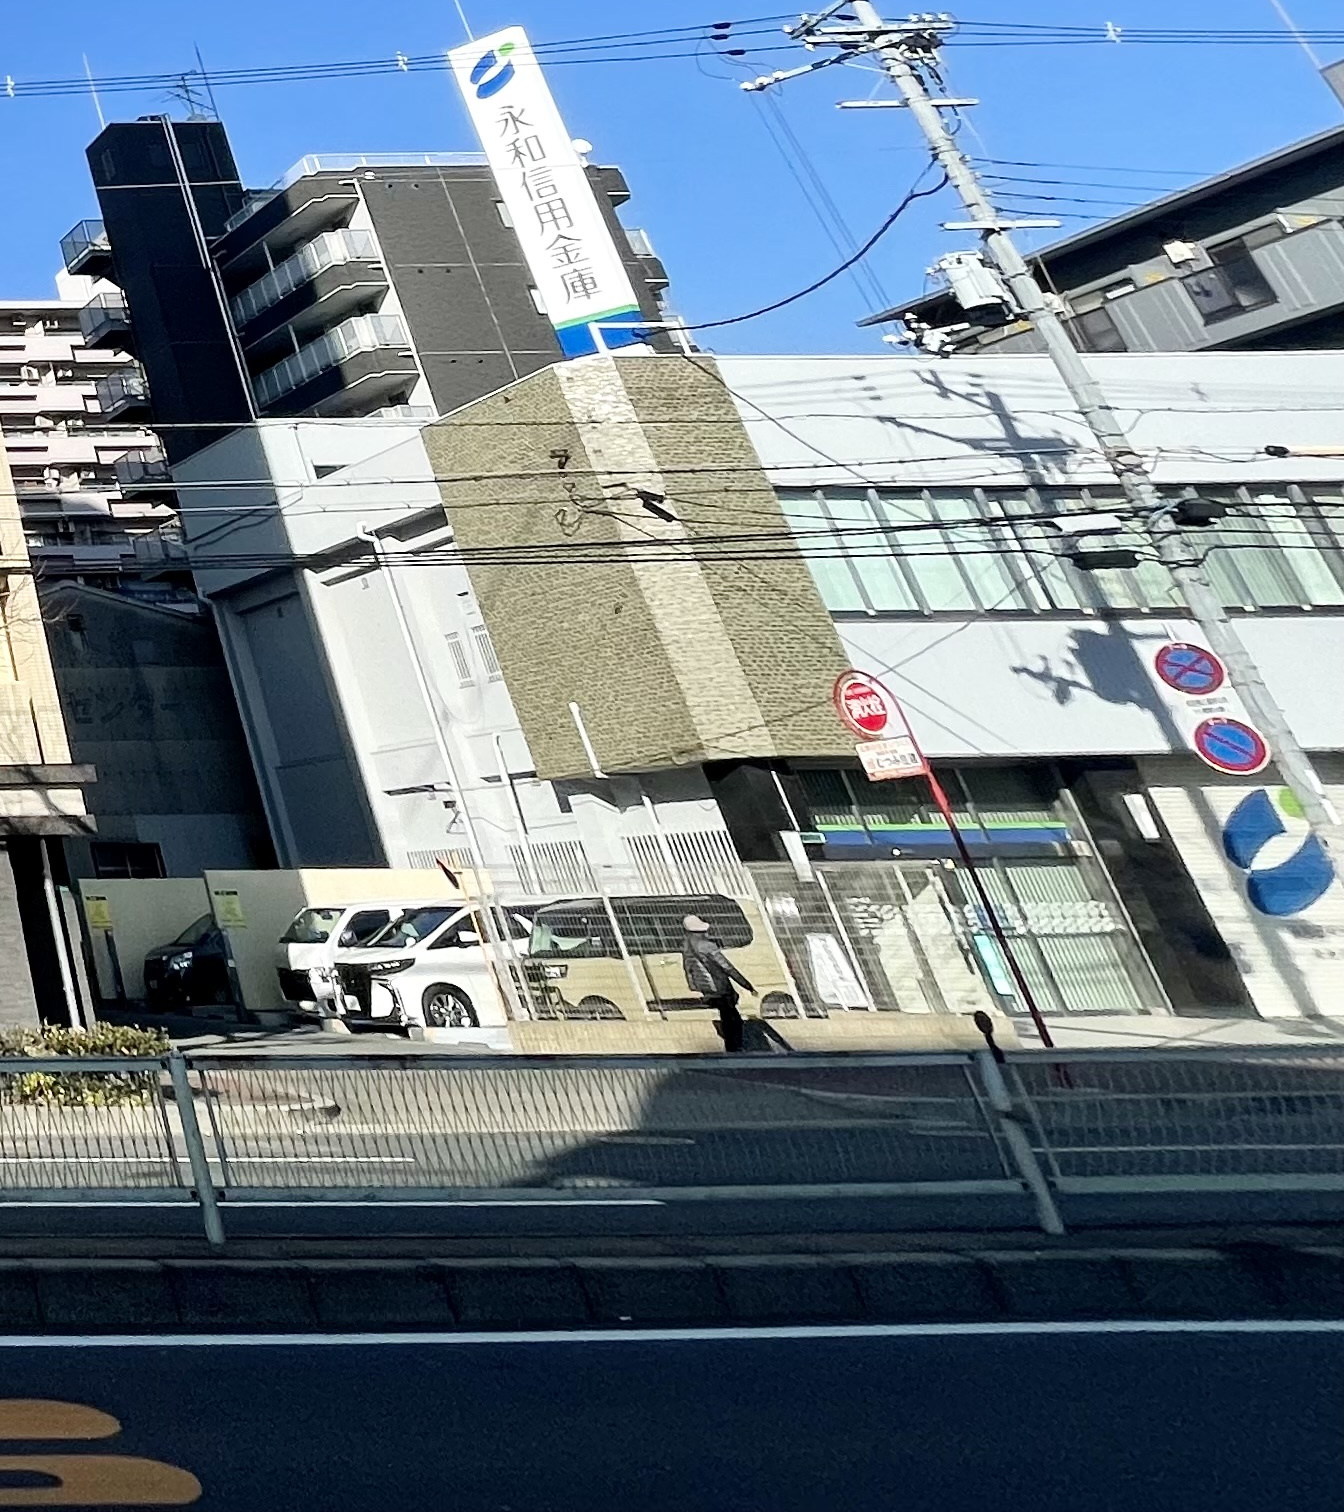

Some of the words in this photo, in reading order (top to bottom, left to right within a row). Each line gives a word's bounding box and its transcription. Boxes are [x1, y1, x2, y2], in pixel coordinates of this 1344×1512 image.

[496, 105, 603, 304] 永和信用金庫
